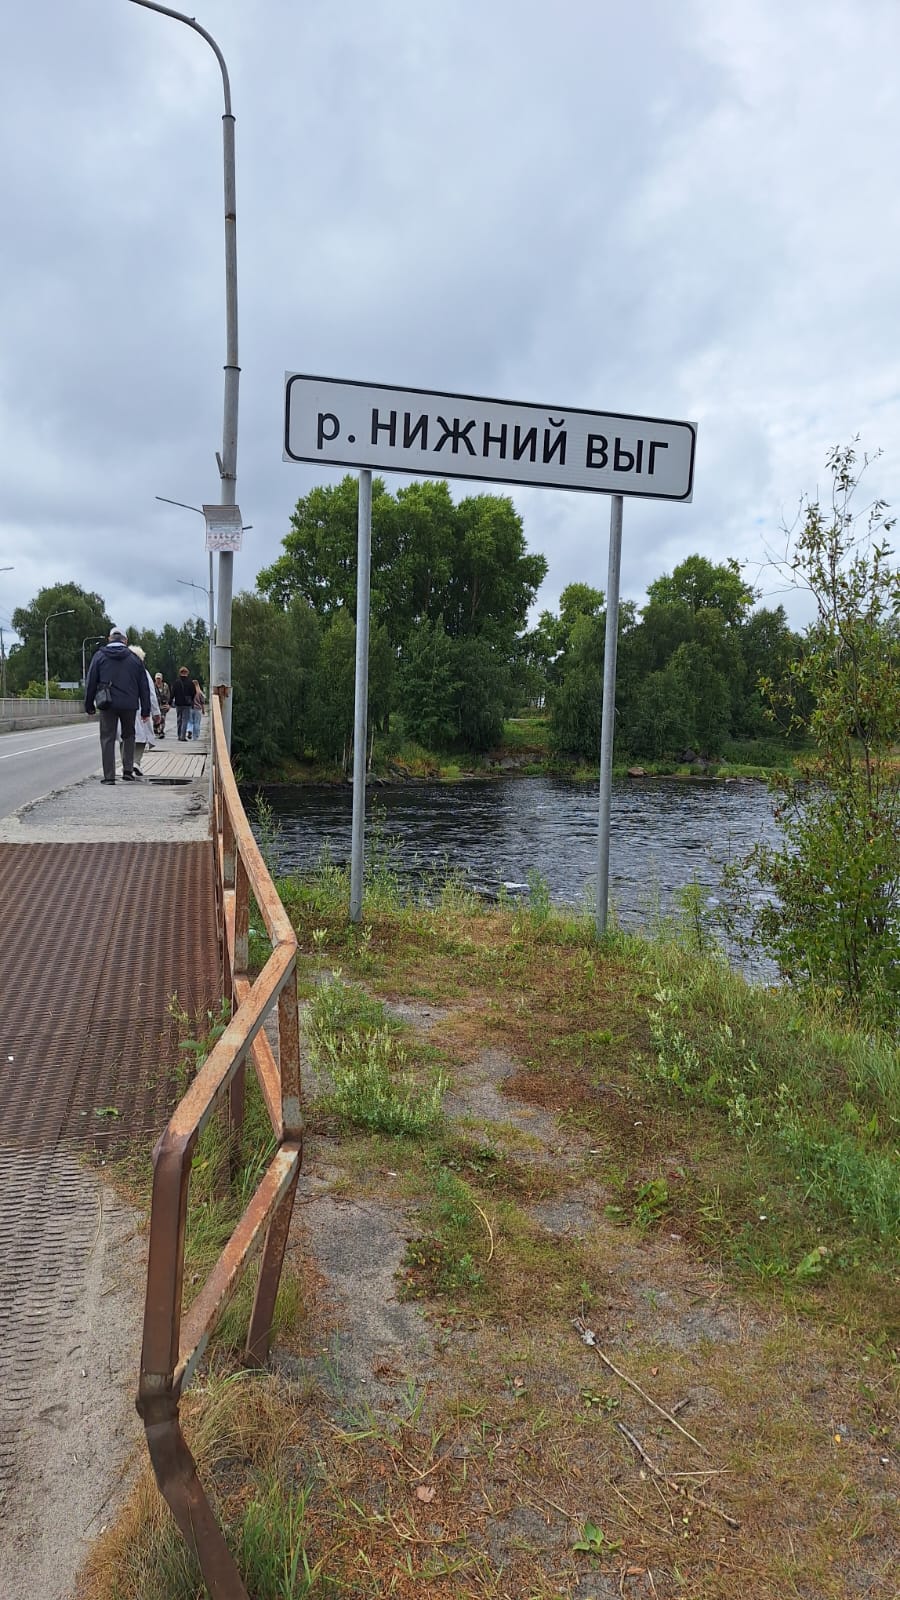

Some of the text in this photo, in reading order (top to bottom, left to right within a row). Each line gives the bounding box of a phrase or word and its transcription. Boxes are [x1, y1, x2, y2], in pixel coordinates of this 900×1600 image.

[317, 408, 669, 475] р. НИЖНИЙ ВЫГ
